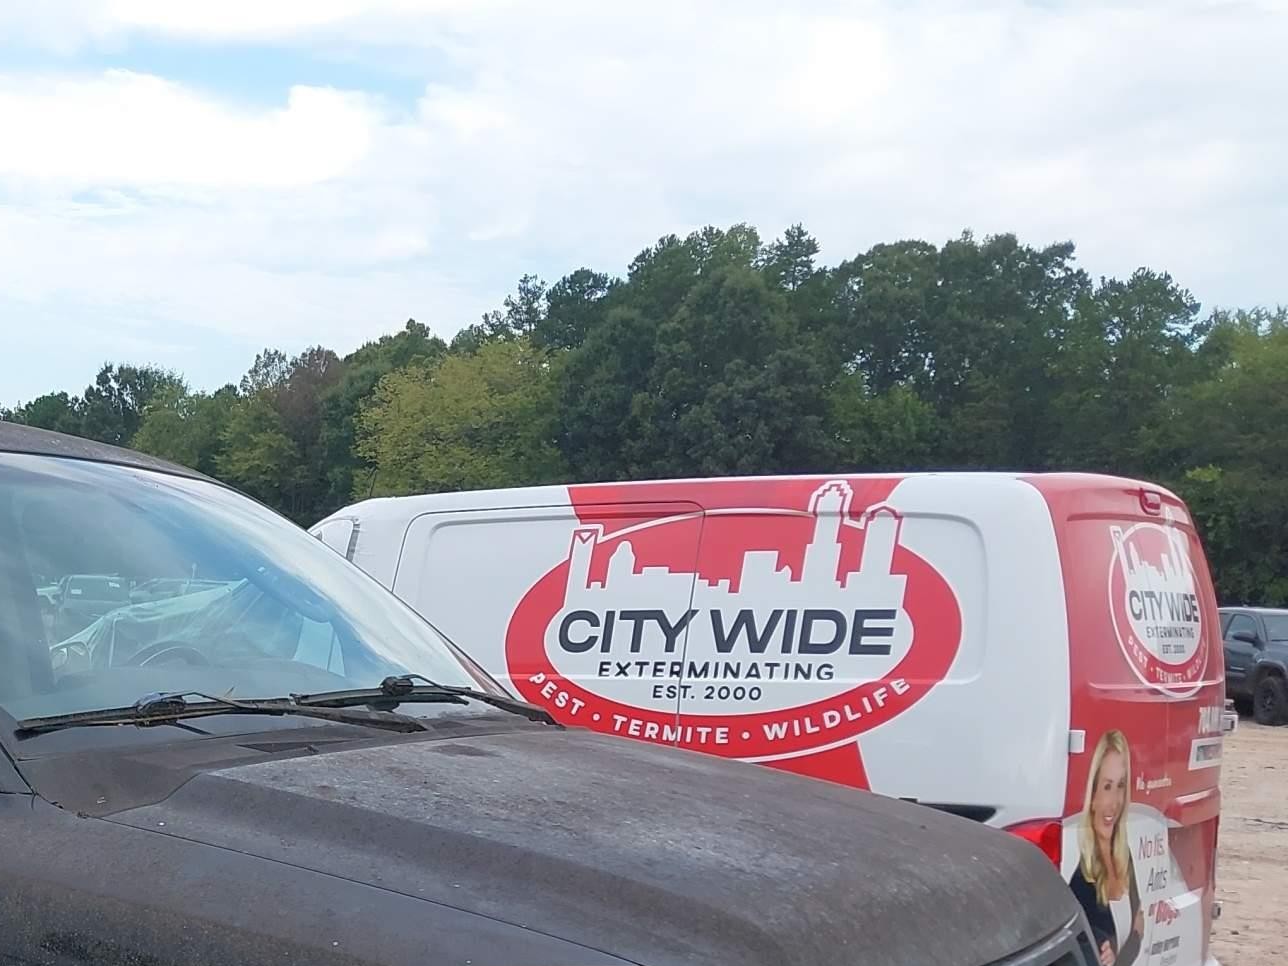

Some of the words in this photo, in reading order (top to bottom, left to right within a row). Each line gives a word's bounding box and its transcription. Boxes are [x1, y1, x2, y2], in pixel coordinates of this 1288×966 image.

[1128, 589, 1163, 621] CITY
[1165, 591, 1199, 623] WIDE
[558, 609, 699, 655] CITY
[710, 609, 897, 656] WIDE
[598, 660, 835, 681] EXTERMINATING
[529, 672, 586, 715] PEST
[612, 714, 730, 744] TERMITE
[763, 678, 911, 742] WILDLIFE
[652, 684, 696, 700] EST.
[705, 685, 763, 701] 2000
